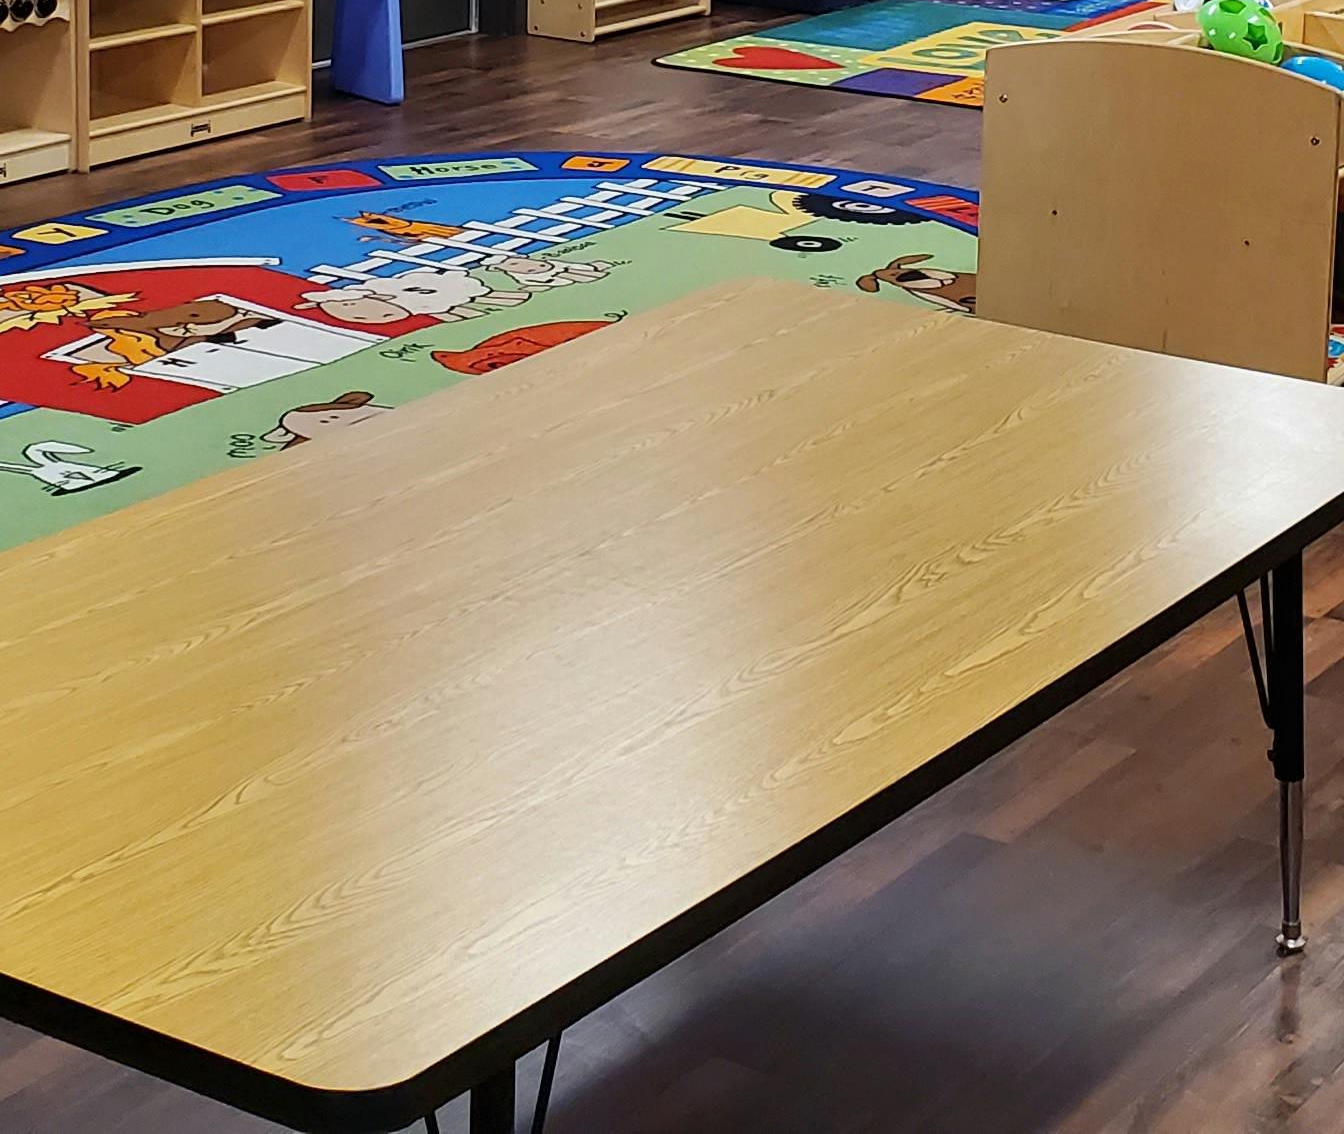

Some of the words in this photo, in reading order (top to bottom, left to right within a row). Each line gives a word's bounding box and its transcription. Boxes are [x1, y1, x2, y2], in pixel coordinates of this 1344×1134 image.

[408, 164, 498, 177] Horse
[714, 165, 768, 180] Pig
[139, 198, 216, 217] Dog
